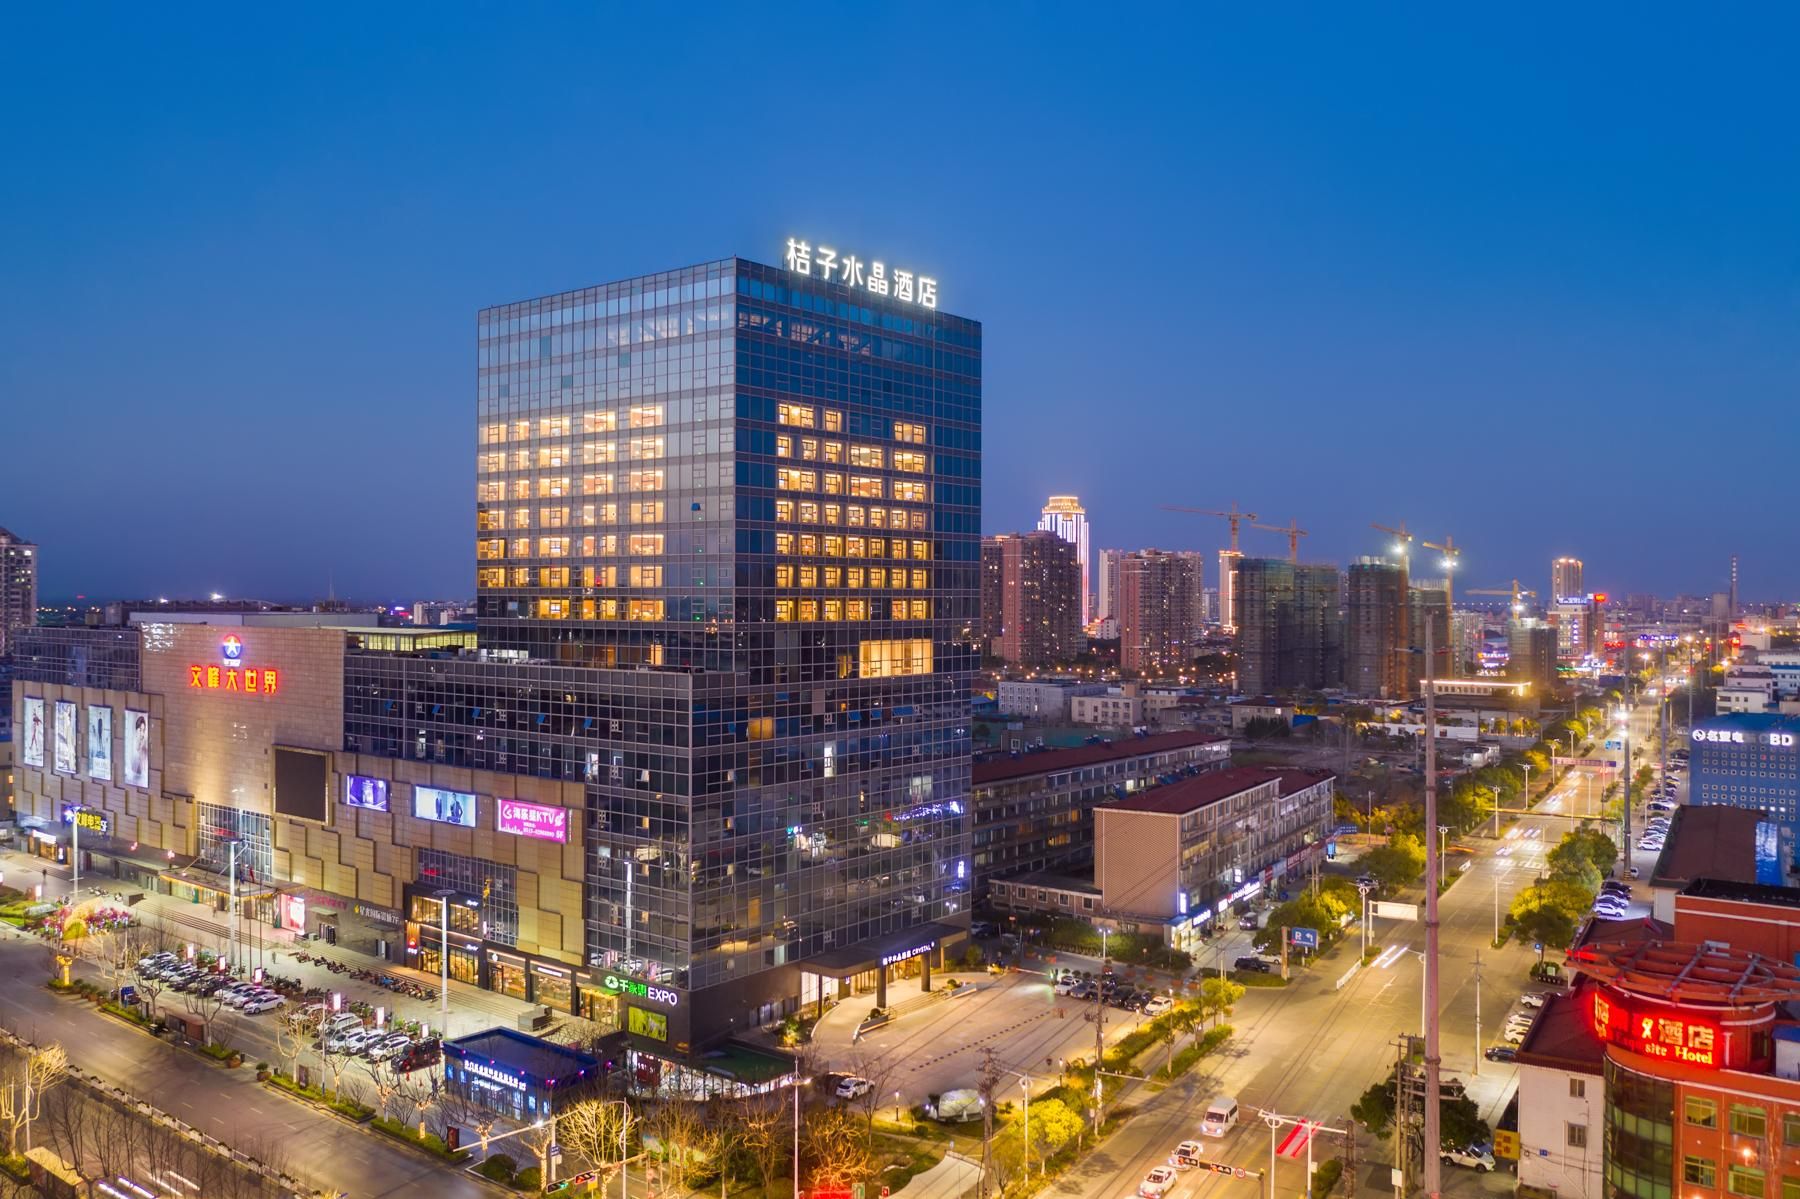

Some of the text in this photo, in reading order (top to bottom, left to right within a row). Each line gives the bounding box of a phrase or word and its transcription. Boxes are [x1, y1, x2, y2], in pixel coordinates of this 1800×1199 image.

[787, 237, 938, 308] 桔子水晶酒店
[190, 665, 277, 694] 文峰大世界
[648, 986, 678, 1006] EXPO
[1675, 1046, 1713, 1065] Hotel
